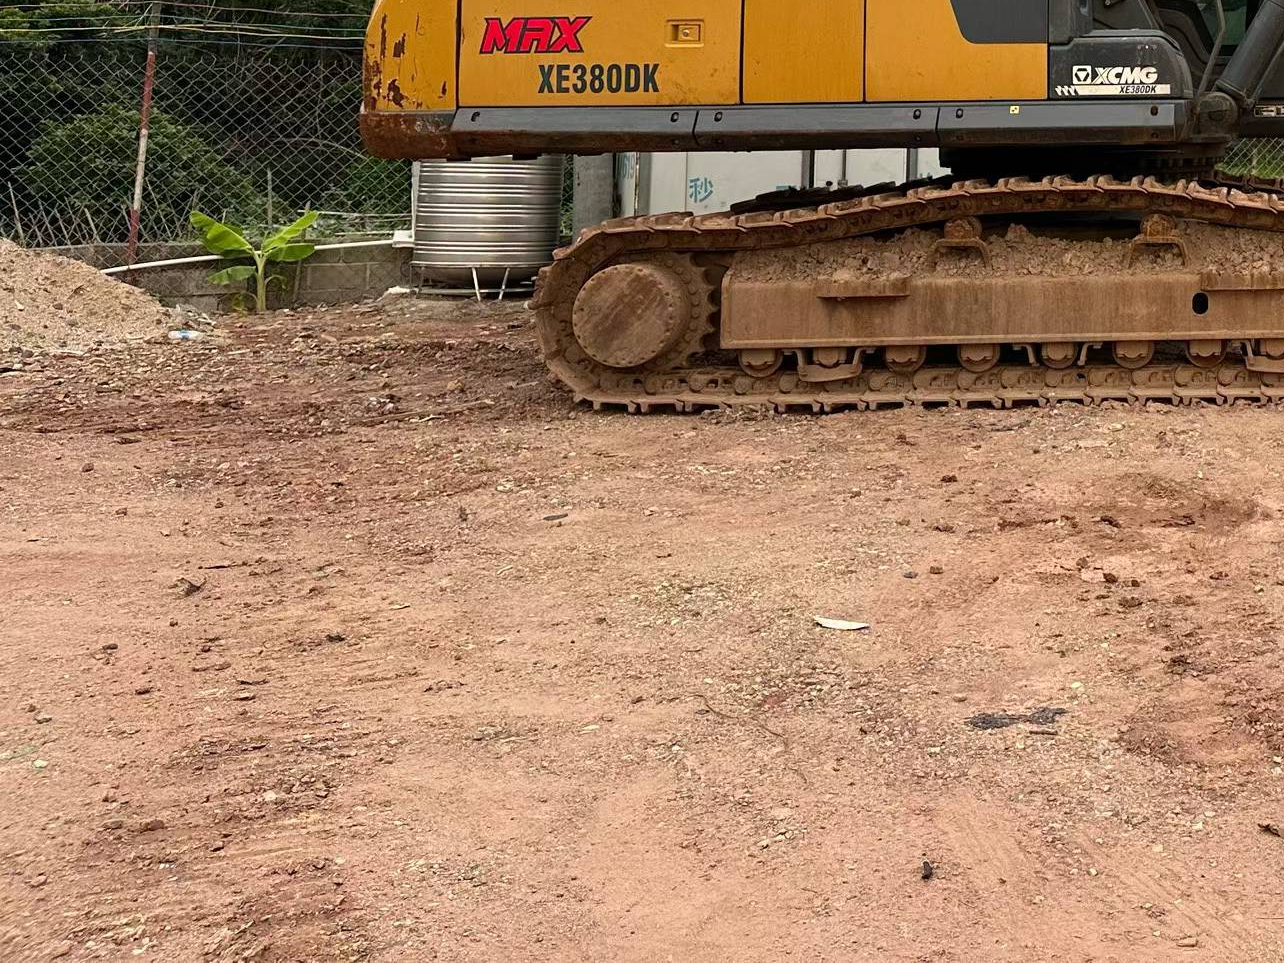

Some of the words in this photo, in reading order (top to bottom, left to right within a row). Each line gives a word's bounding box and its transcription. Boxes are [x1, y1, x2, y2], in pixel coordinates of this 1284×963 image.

[480, 16, 593, 54] MAX
[538, 63, 660, 94] XE380DK
[1091, 66, 1159, 85] XCMG
[1119, 85, 1157, 94] XE380DK
[689, 177, 714, 204] 秒
